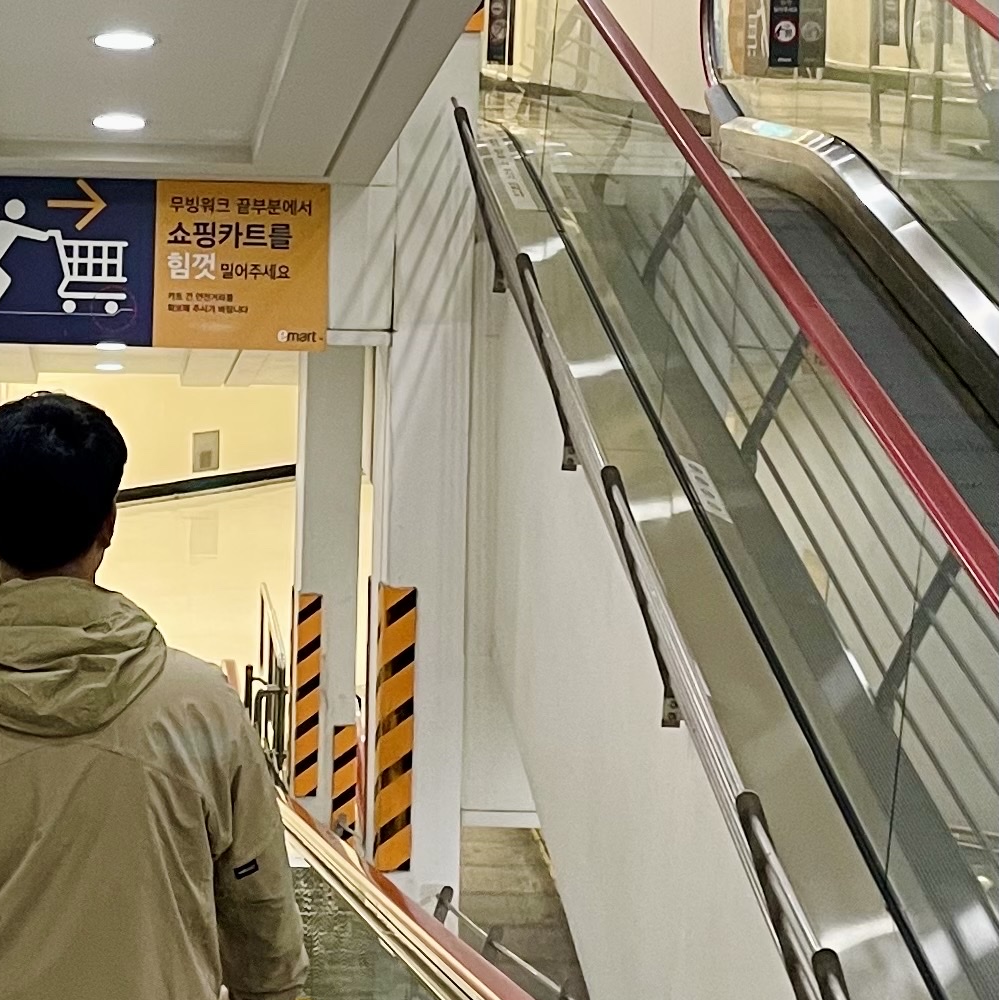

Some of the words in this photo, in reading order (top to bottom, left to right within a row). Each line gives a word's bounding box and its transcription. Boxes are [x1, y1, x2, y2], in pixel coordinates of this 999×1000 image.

[169, 196, 231, 215] 무빙워크
[235, 197, 312, 216] 끝부분에서
[167, 221, 293, 250] 쇼핑카트를
[167, 252, 216, 281] 힘껏
[220, 263, 291, 281] 밀어주세요
